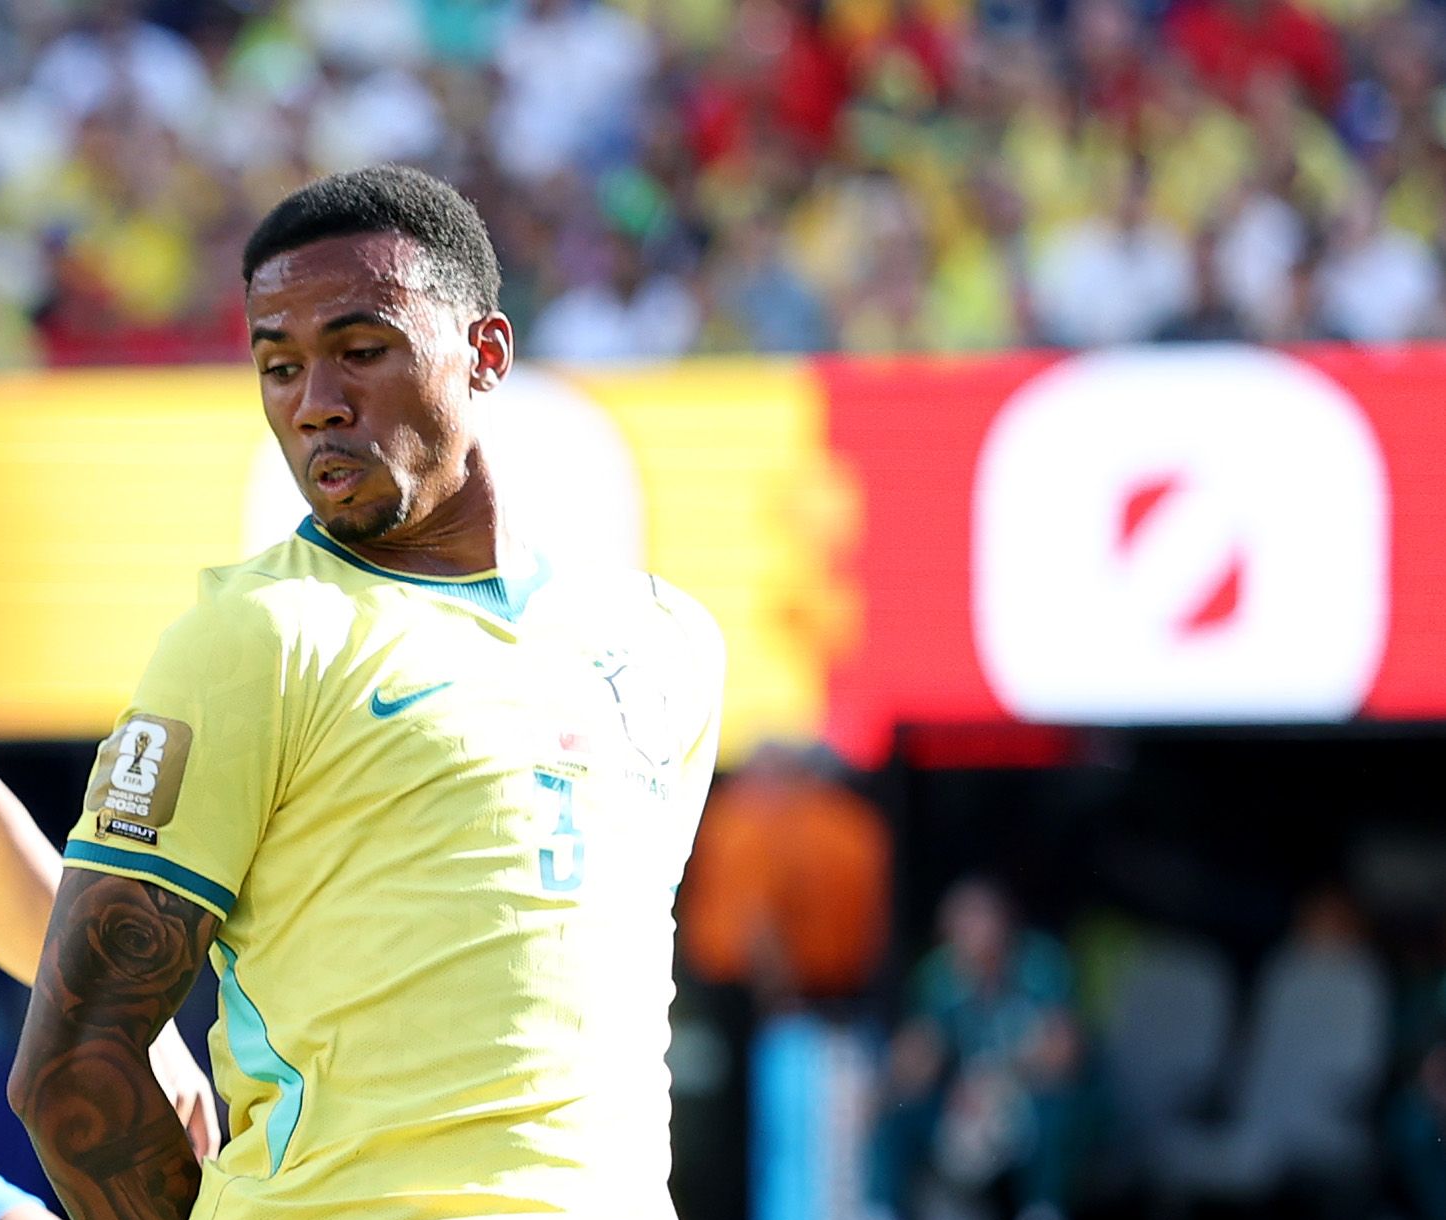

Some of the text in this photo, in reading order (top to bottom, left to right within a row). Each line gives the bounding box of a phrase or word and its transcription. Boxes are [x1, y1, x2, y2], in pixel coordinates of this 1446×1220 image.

[123, 775, 143, 786] FIFA
[104, 796, 150, 816] 2026
[111, 820, 156, 839] DEBUT
